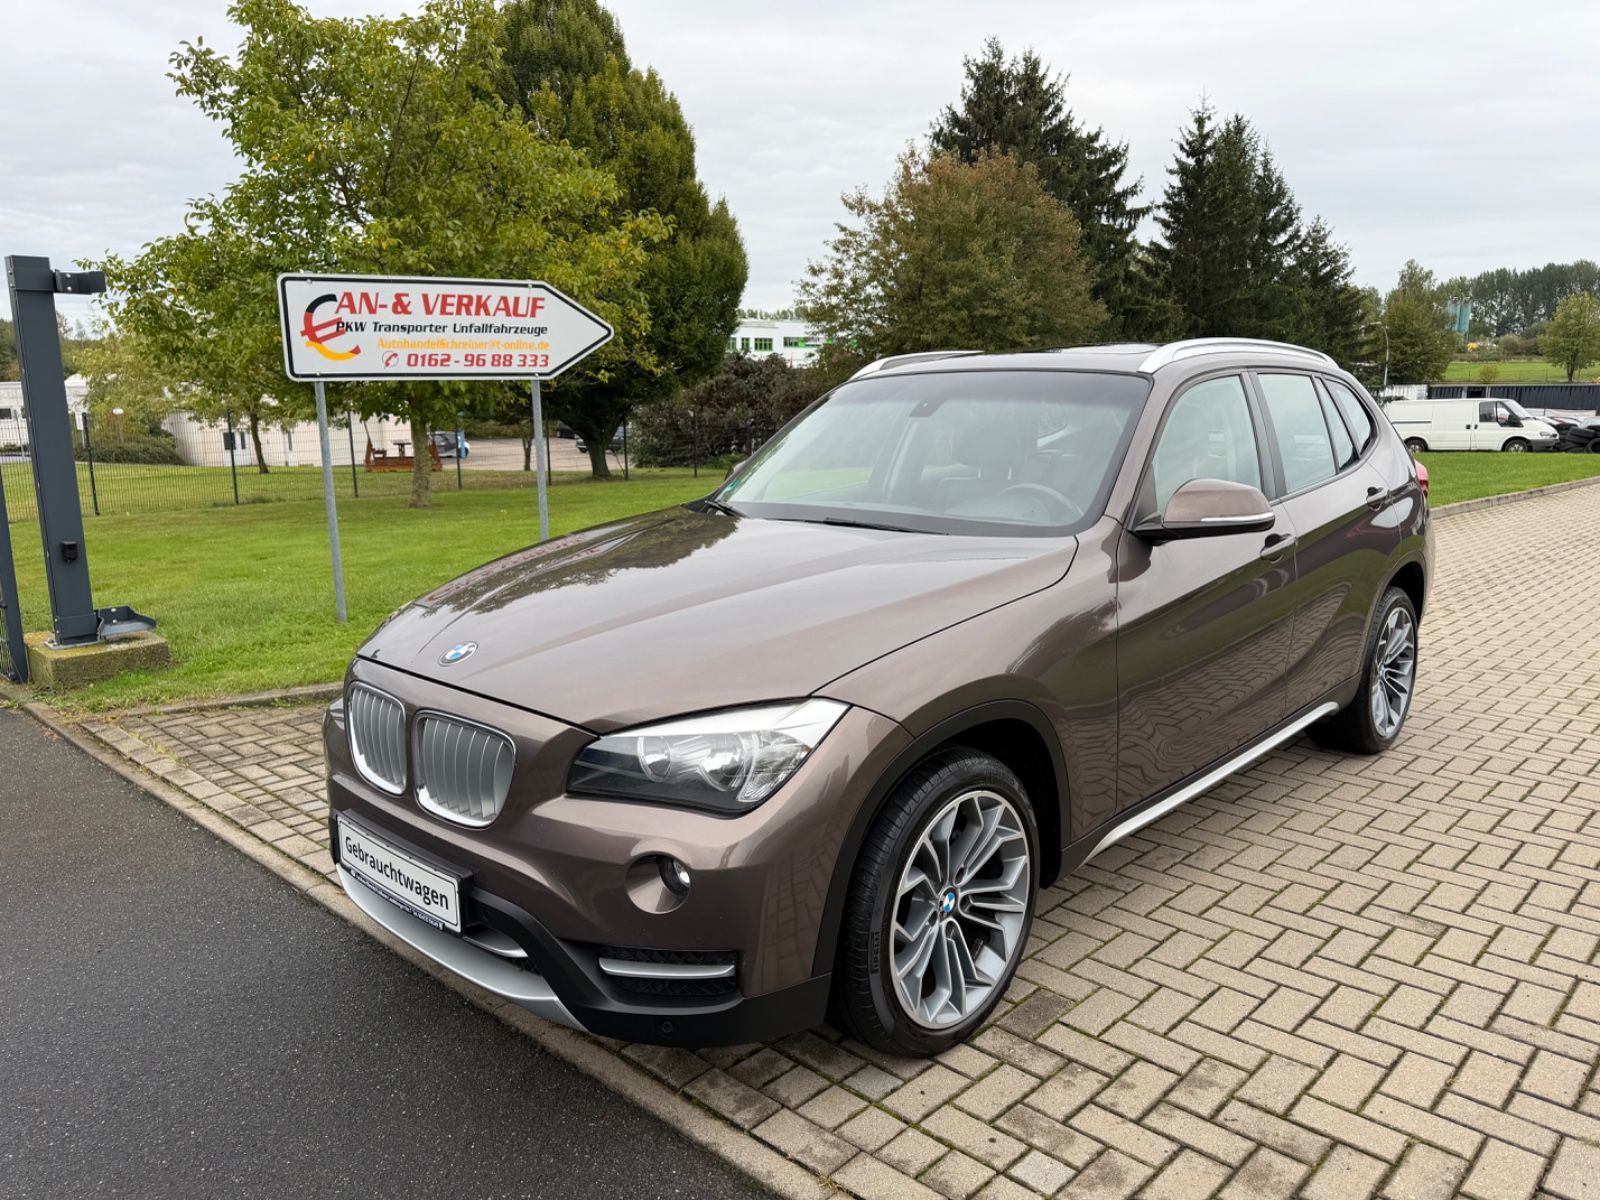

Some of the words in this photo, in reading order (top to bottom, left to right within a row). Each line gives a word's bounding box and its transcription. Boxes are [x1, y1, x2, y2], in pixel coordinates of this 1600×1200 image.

[421, 293, 546, 318] VERKAUF
[335, 321, 367, 333] PKW
[372, 321, 448, 335] Transporter
[453, 323, 548, 337] Unfallfahrzeuge
[463, 353, 487, 367] 96
[491, 353, 513, 368] 88
[517, 353, 550, 368] 333
[345, 837, 449, 910] Gebrauchtwagen
